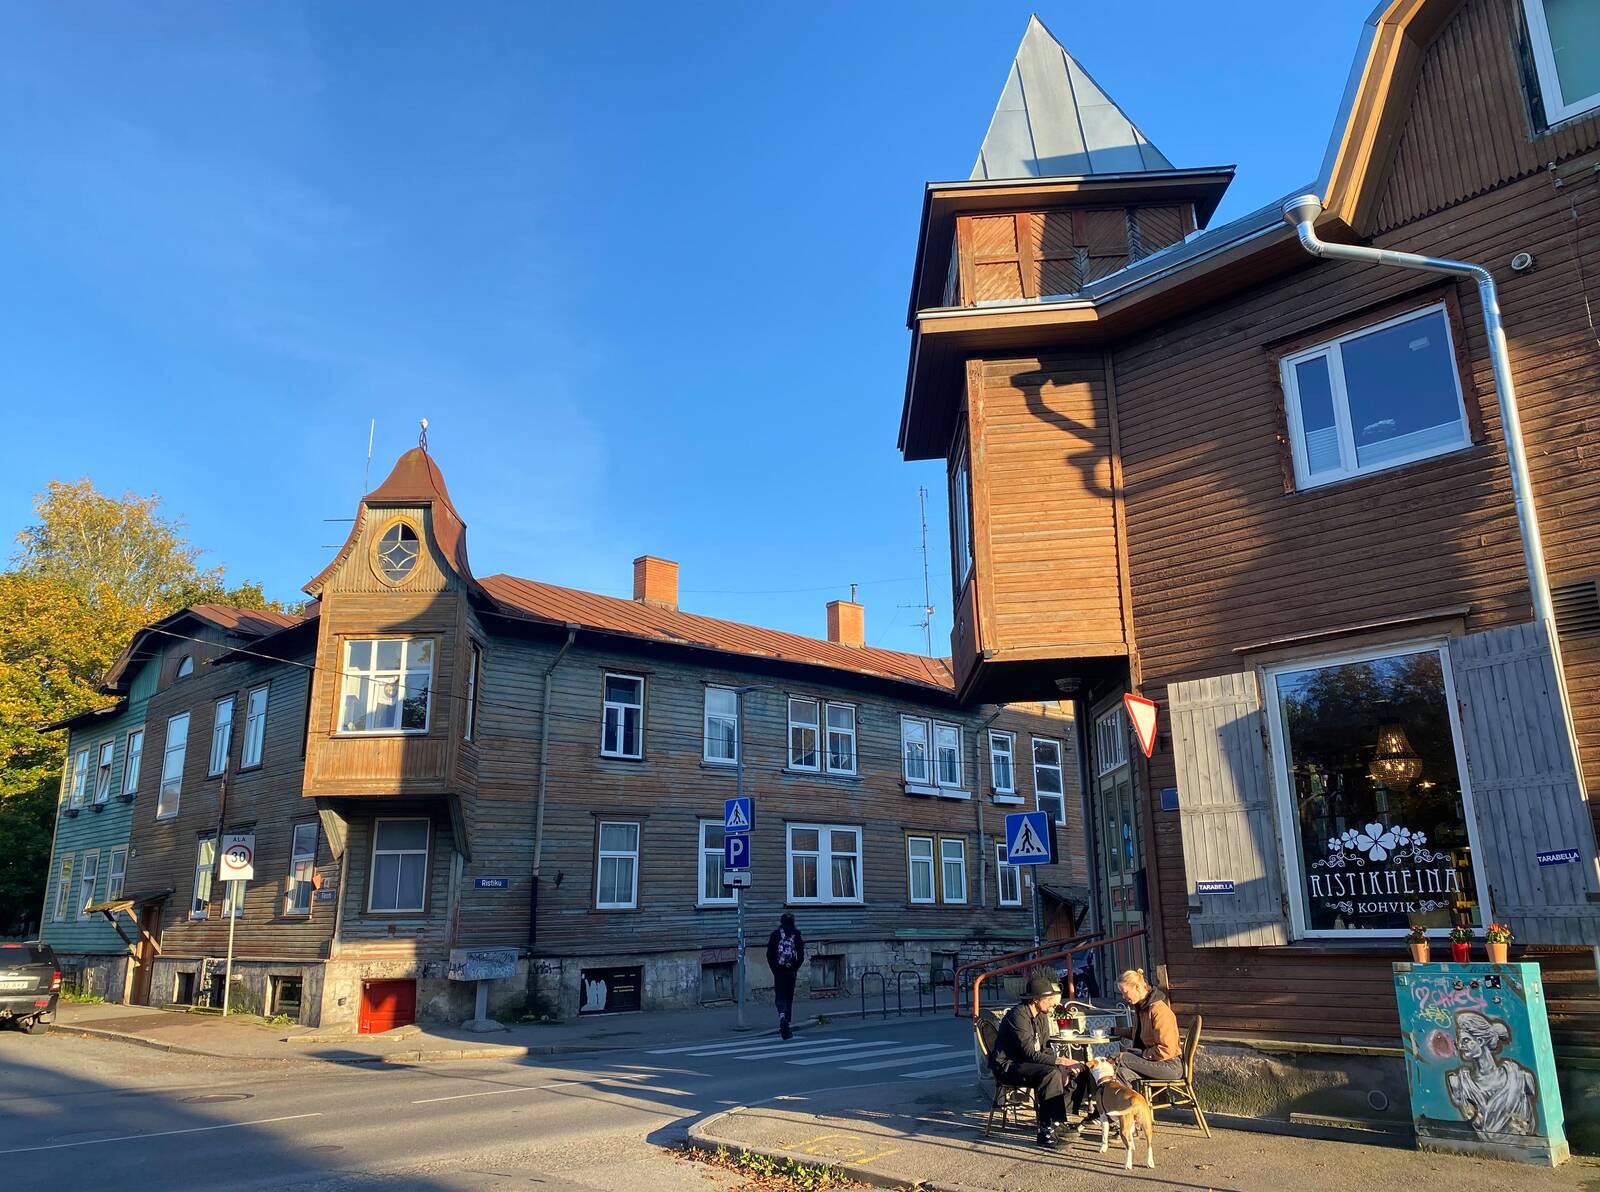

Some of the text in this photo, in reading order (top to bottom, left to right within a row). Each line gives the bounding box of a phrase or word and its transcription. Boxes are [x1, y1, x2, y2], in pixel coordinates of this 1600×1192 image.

[231, 851, 246, 863] 30
[730, 838, 744, 865] P
[1537, 852, 1579, 863] TARABELLA
[481, 879, 502, 887] Ristiku
[1310, 868, 1461, 898] RISTIKHEINA
[1358, 902, 1416, 913] KOHVIK
